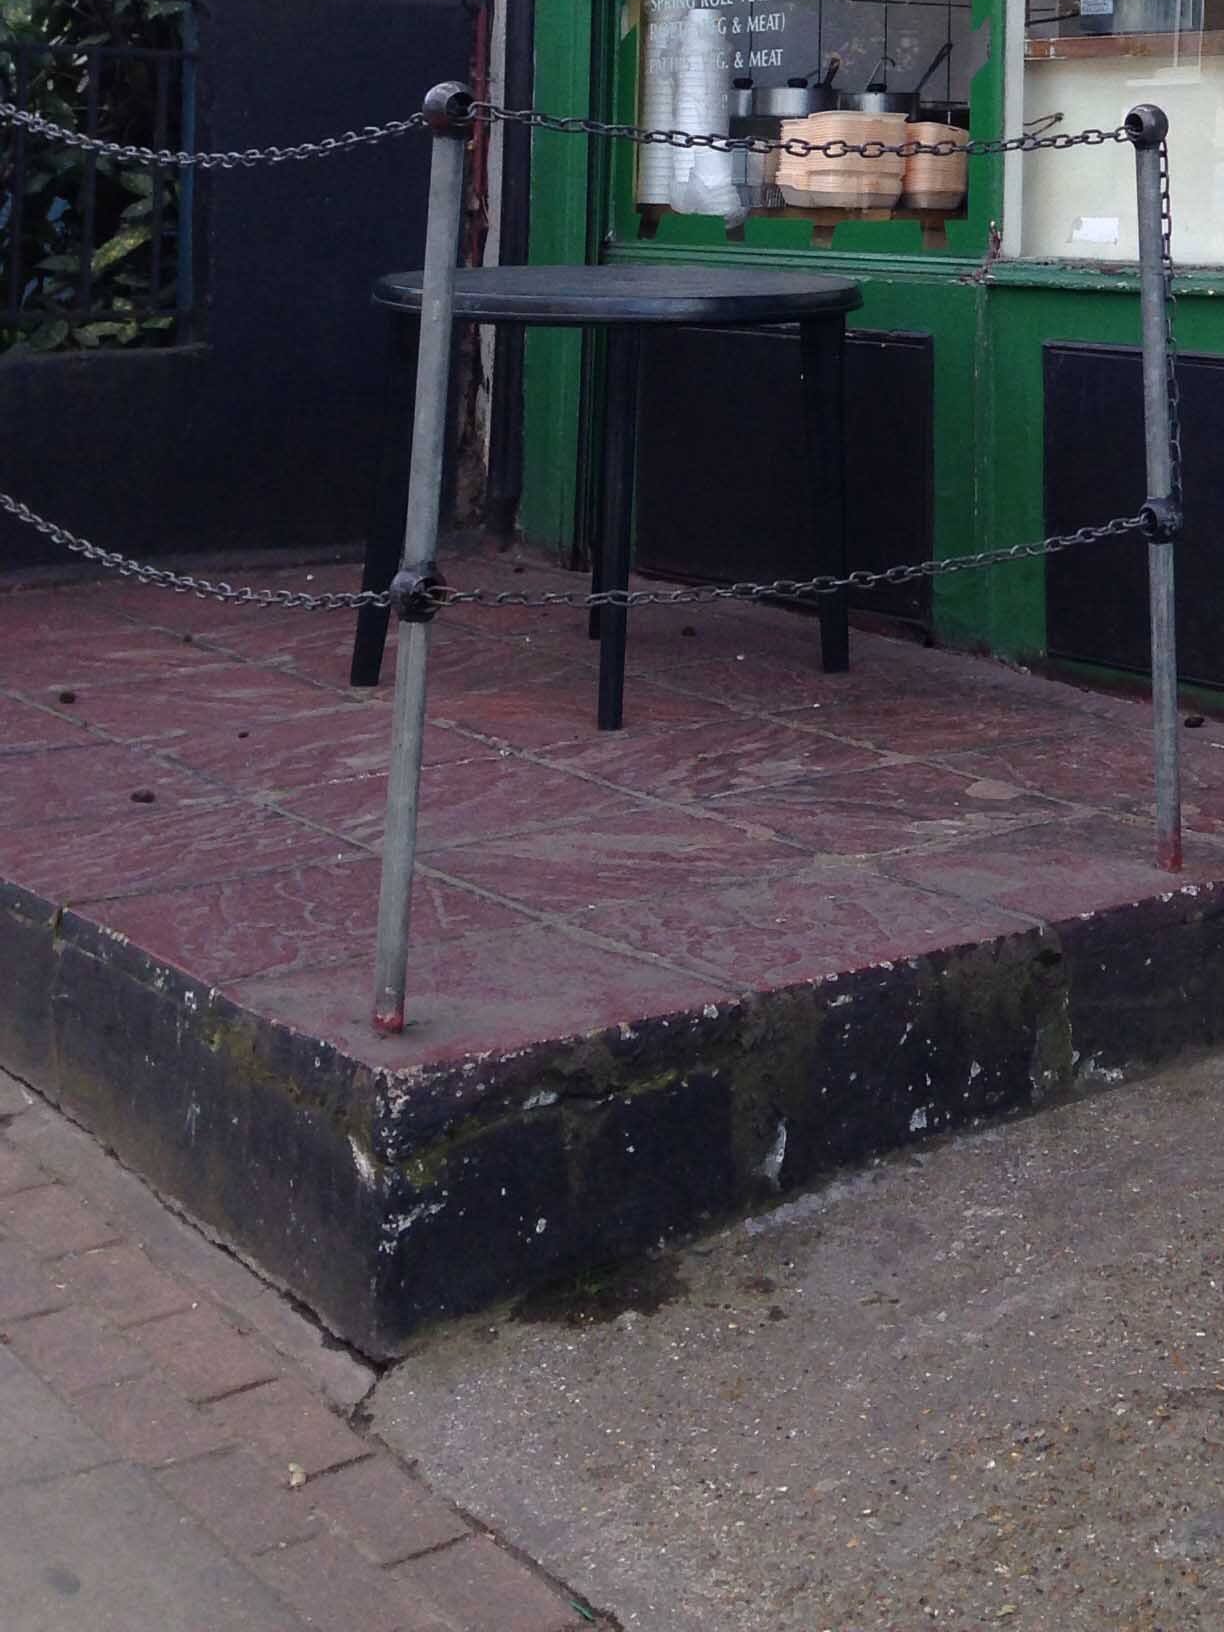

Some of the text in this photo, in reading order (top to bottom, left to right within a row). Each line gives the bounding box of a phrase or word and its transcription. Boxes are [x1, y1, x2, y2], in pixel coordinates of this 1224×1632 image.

[731, 16, 742, 35] &
[746, 12, 786, 33] MEAT)
[734, 50, 744, 69] &
[749, 48, 784, 68] MEAT
